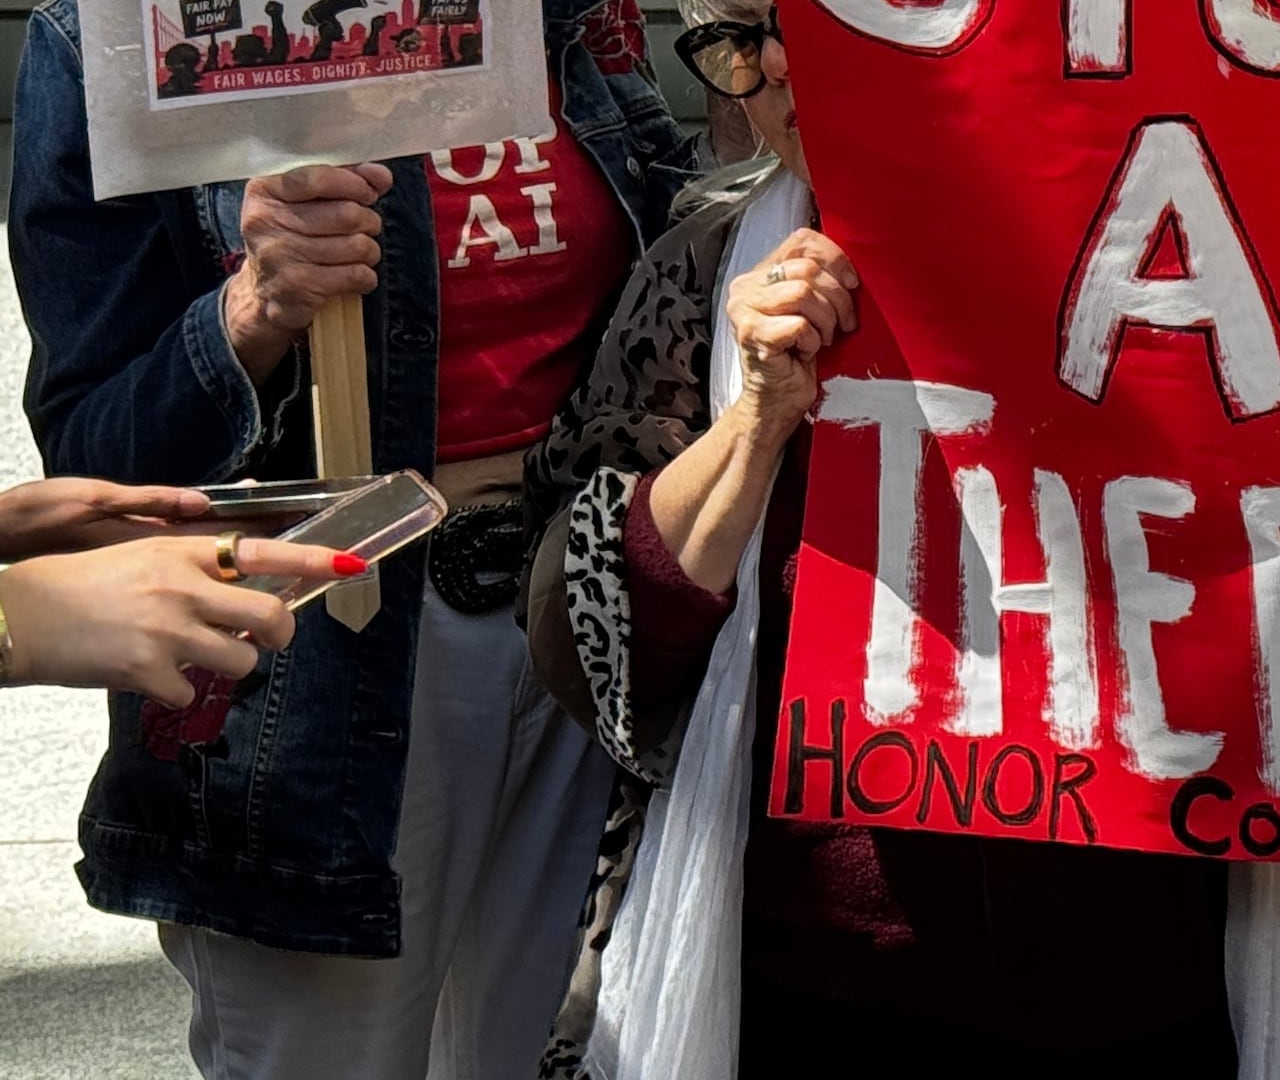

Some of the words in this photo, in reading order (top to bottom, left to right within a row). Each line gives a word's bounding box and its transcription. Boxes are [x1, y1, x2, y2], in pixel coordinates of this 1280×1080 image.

[186, 0, 211, 16] FAIR
[196, 11, 226, 27] NOW
[213, 71, 245, 89] FAIR
[448, 182, 567, 268] AI
[784, 697, 1098, 843] HONOR
